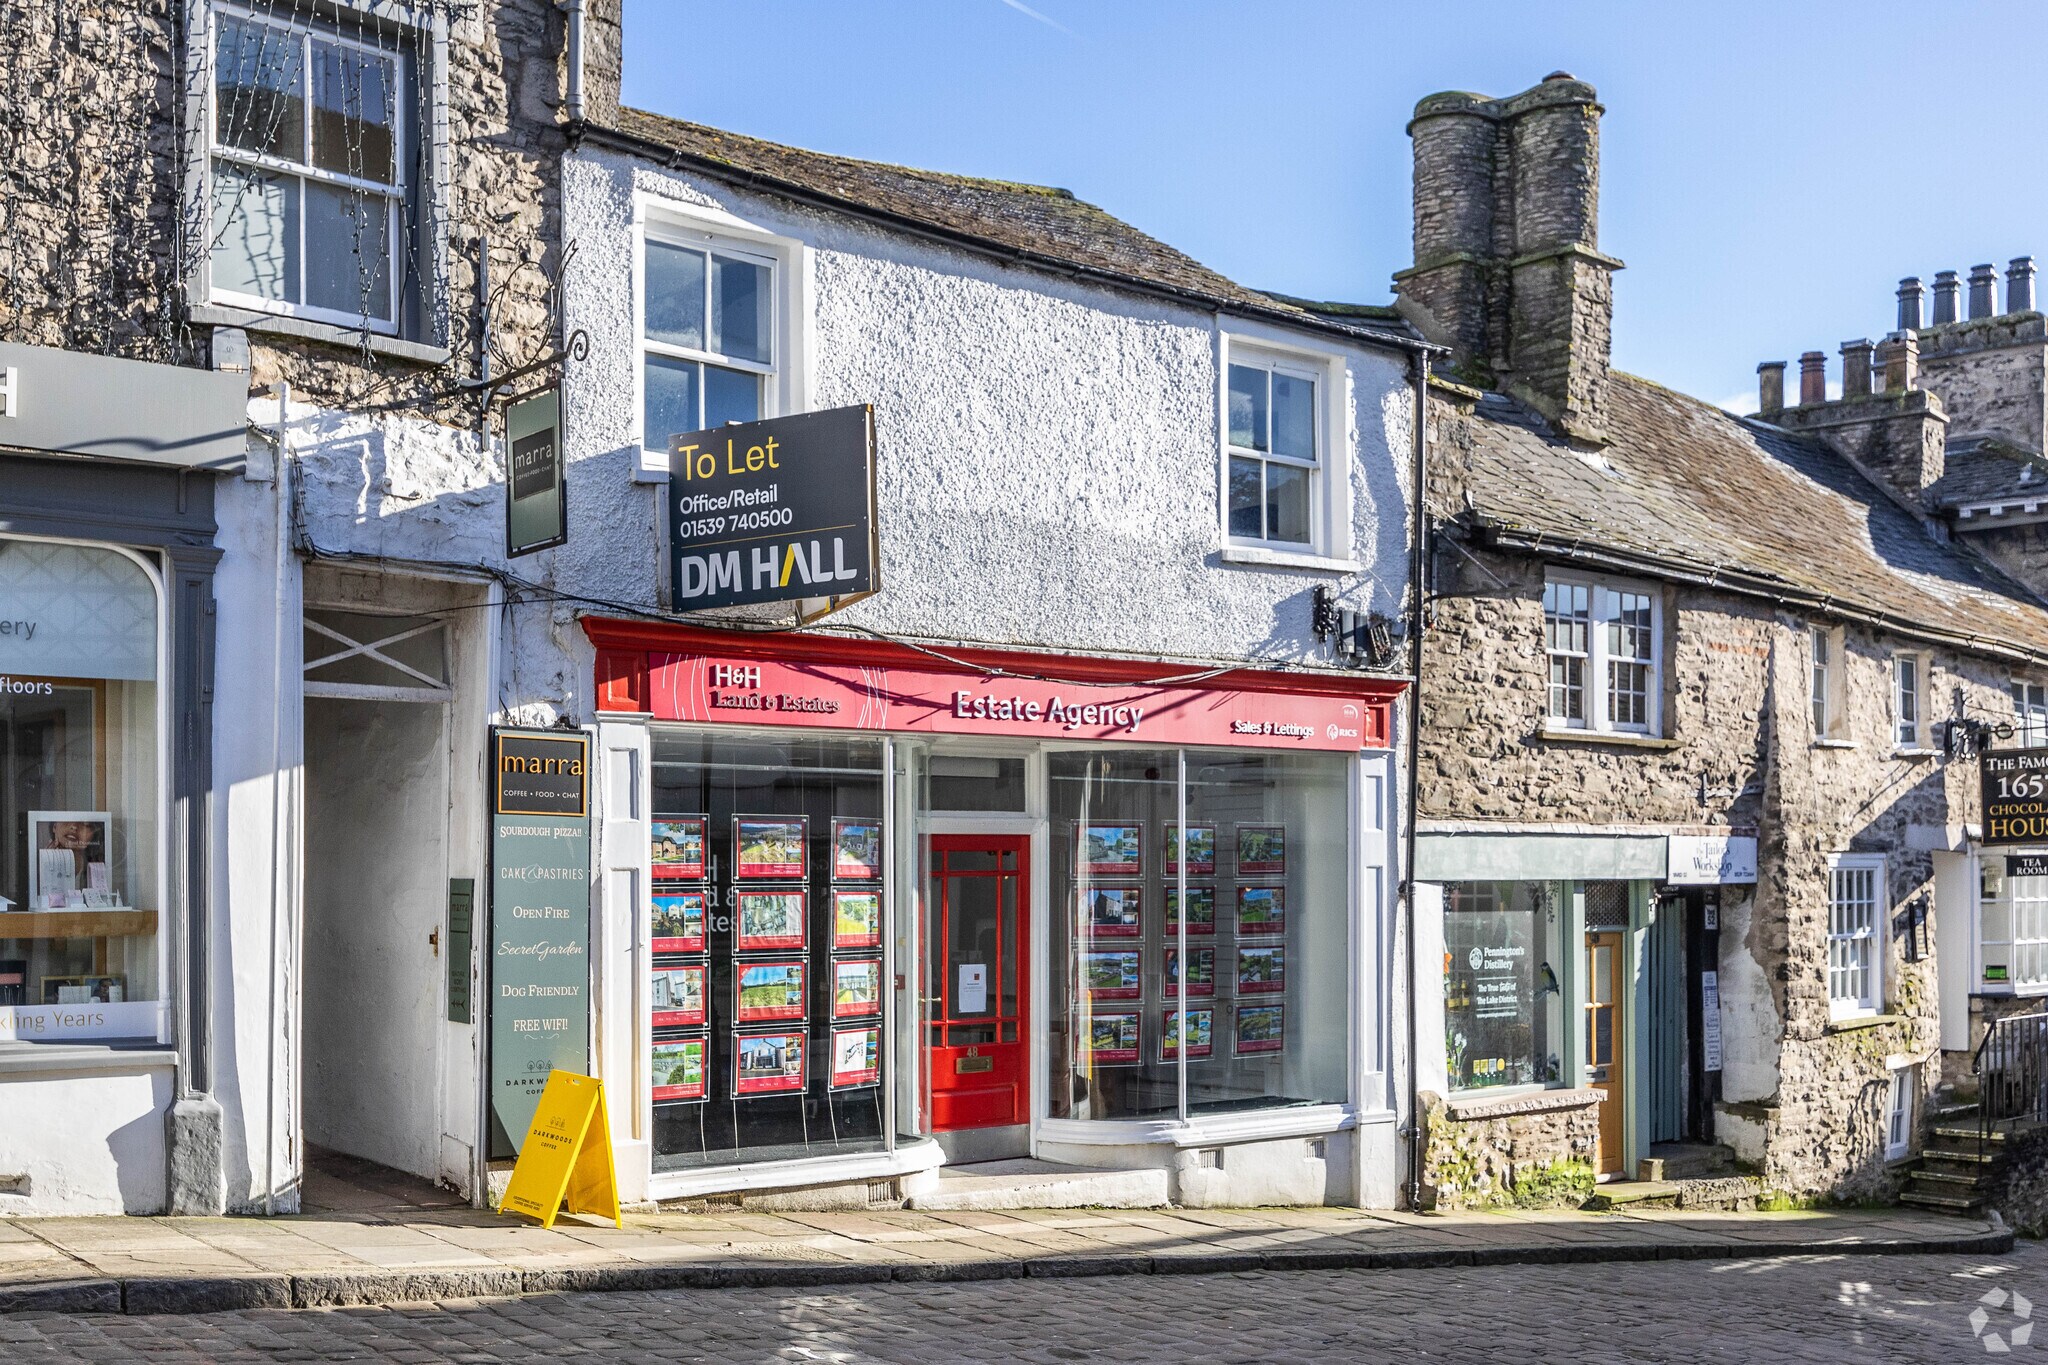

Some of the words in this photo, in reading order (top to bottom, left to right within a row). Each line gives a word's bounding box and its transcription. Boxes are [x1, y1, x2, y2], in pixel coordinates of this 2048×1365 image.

[515, 444, 552, 469] marra
[678, 444, 716, 481] To
[728, 436, 779, 475] Let
[680, 484, 778, 514] Office/Retail
[680, 517, 726, 538] 01539
[729, 507, 793, 531] 740500
[681, 551, 742, 598] DM
[752, 537, 857, 590] HALL
[0, 621, 36, 640] ery
[715, 664, 761, 688] H&H
[0, 677, 53, 695] floors
[716, 690, 761, 709] Land
[766, 694, 777, 710] &
[781, 693, 840, 712] Estates
[957, 690, 1040, 721] Estate
[1049, 696, 1144, 732] Agency
[1235, 720, 1262, 734] Sales
[1263, 721, 1272, 734] &
[1274, 722, 1315, 738] Lettings
[1339, 728, 1358, 738] RICS
[504, 755, 583, 775] marra
[1986, 758, 2015, 771] THE
[2018, 756, 2048, 769] FAM
[503, 789, 528, 797] COFFEE
[535, 790, 555, 798] FOOD
[562, 791, 580, 799] CHAT
[1997, 773, 2048, 798] 165
[500, 826, 550, 838] SOURDOUGH
[1990, 817, 2048, 838] HOU
[1693, 856, 1732, 874] Workshop
[2016, 866, 2048, 876] ROOM
[2022, 858, 2041, 867] TEA
[501, 867, 526, 879] CAKE
[538, 868, 584, 880] PASTRIES
[512, 906, 543, 918] OPEN
[544, 906, 570, 918] FIRE
[1484, 946, 1525, 958] Pennington's
[1484, 959, 1514, 970] Distillery
[502, 985, 526, 997] DOG
[528, 985, 579, 997] FRIENDLY
[53, 1010, 104, 1028] Years
[513, 1019, 540, 1032] FREE
[542, 1018, 568, 1031] WIFI!
[967, 1046, 978, 1058] 48
[533, 1129, 573, 1144] DARKWOODS
[540, 1141, 557, 1150] COFFEE
